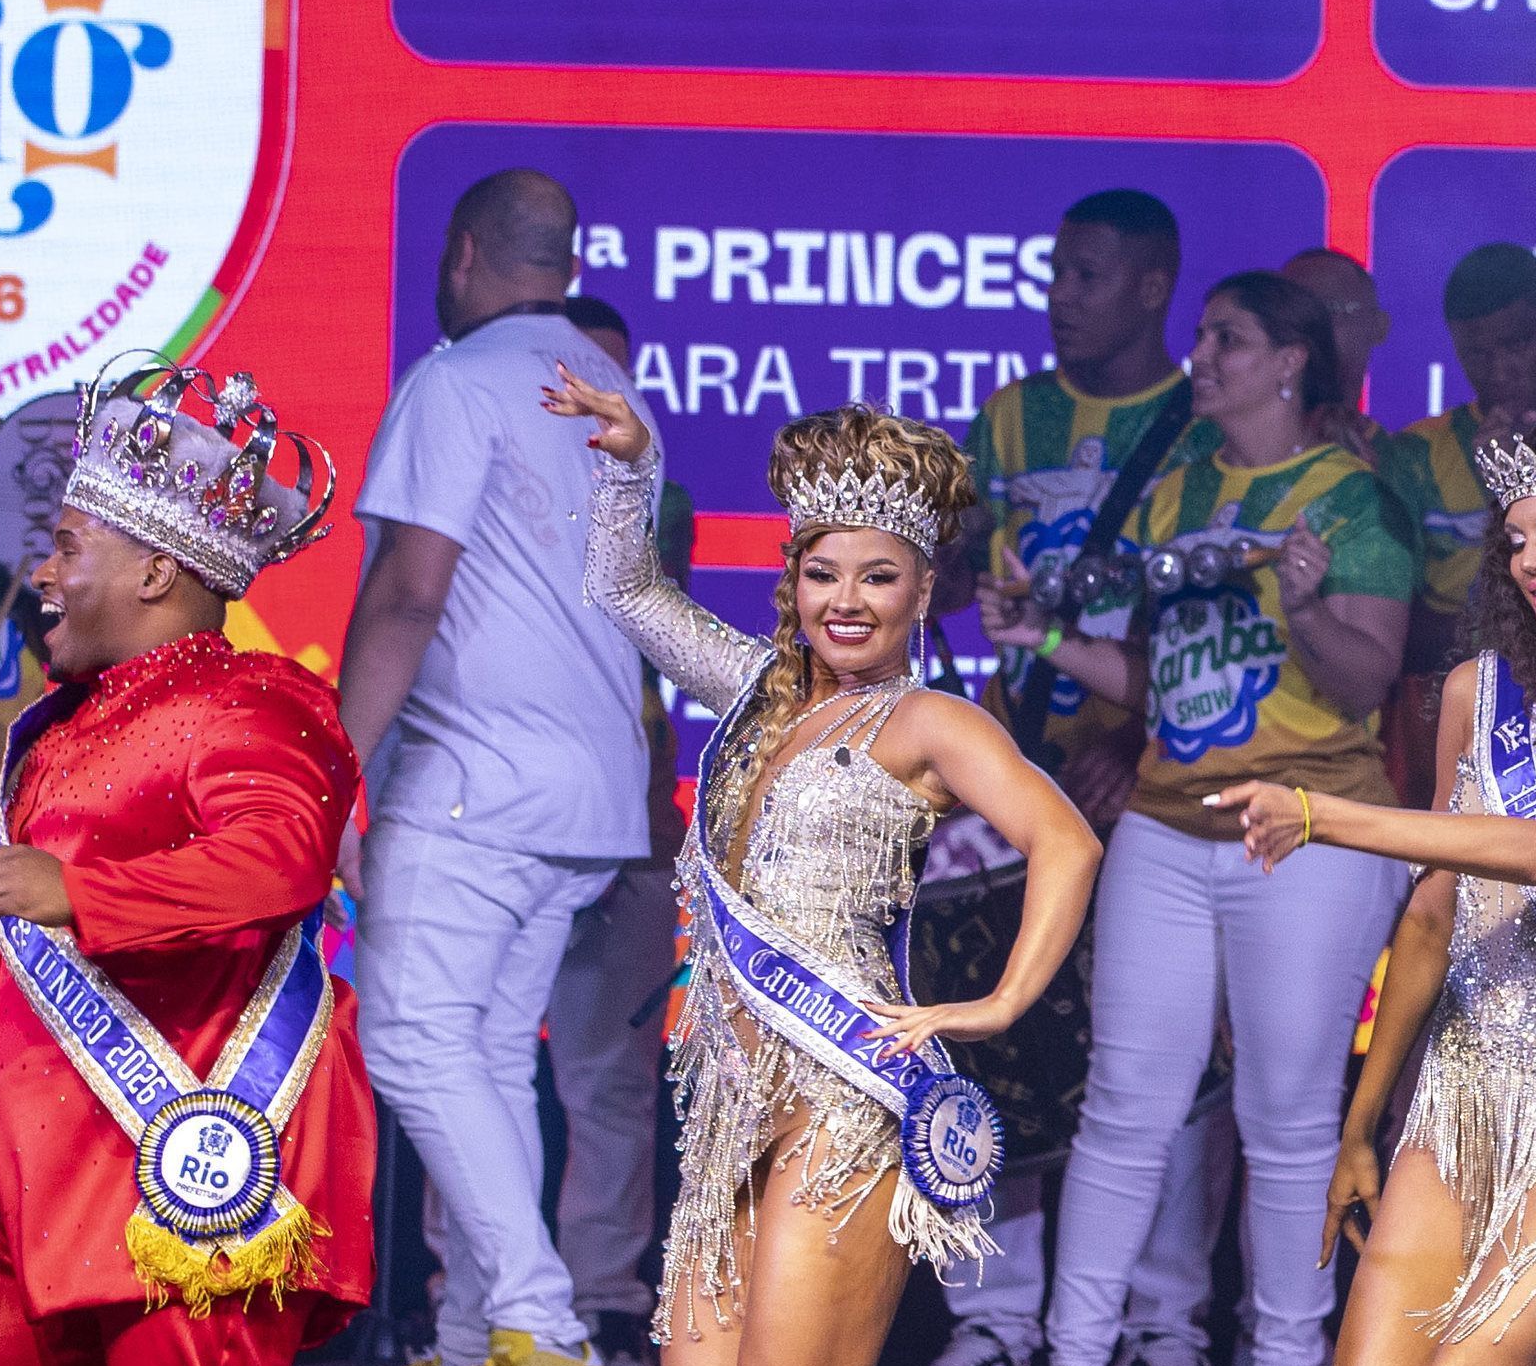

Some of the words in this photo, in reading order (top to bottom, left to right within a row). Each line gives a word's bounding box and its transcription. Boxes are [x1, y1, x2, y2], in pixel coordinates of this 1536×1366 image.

[654, 226, 1058, 310] PRINCES
[634, 343, 801, 419] ARA
[1175, 688, 1233, 724] SHOW
[748, 949, 858, 1042] Carnaval
[105, 1036, 170, 1106] 2026
[179, 1154, 230, 1189] Rio
[943, 1126, 977, 1166] Rio
